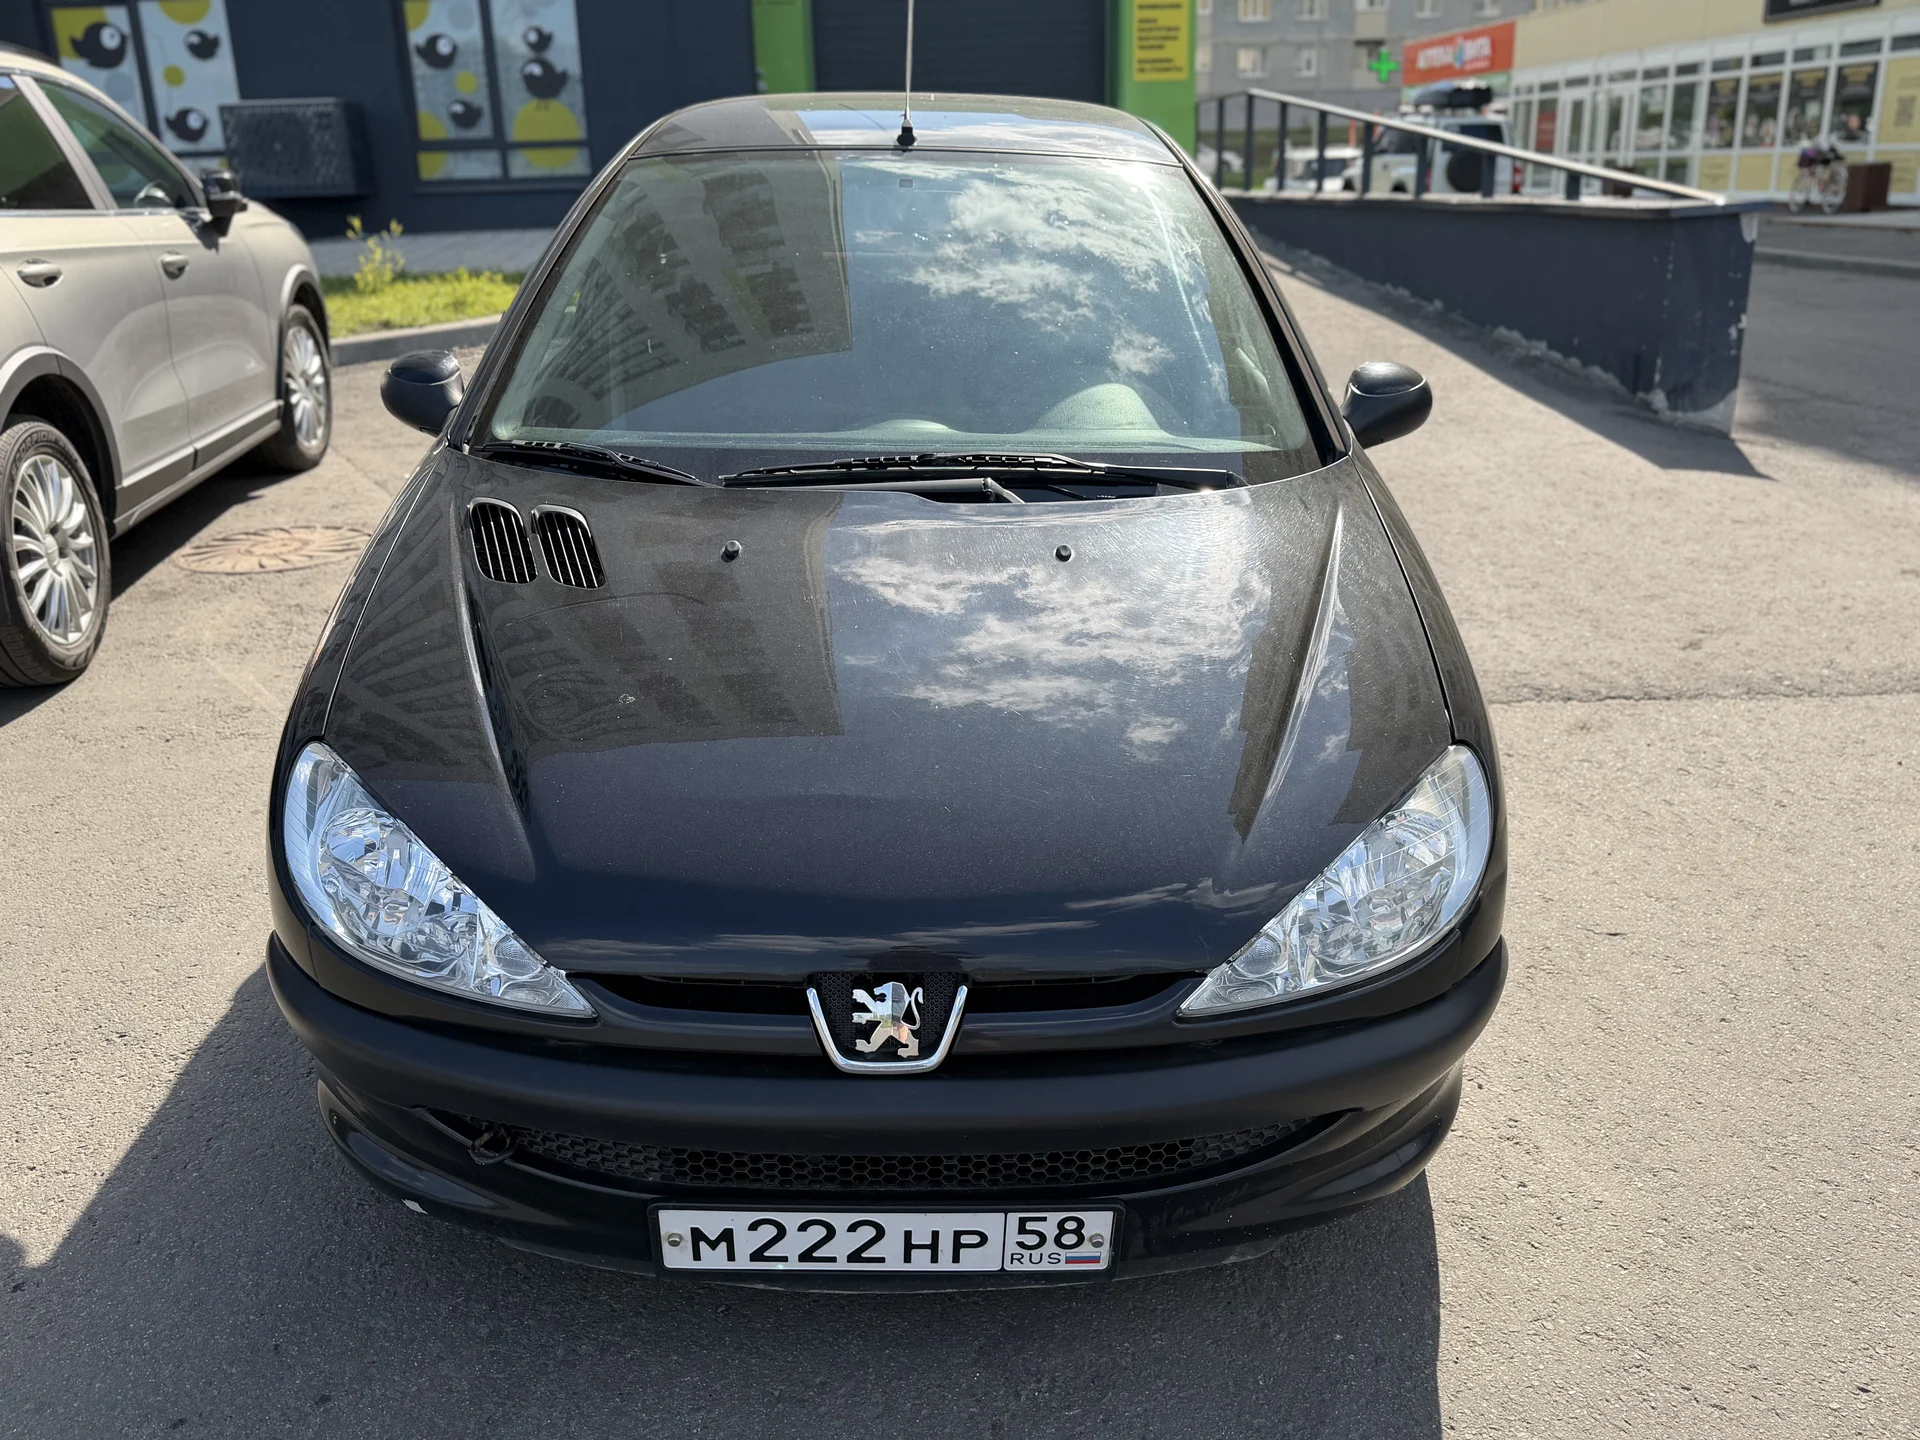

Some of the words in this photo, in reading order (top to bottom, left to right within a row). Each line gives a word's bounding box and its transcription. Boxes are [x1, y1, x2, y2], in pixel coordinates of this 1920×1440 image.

[690, 1217, 989, 1264] М222НР
[1015, 1215, 1086, 1251] 58
[1010, 1252, 1061, 1265] RUS
